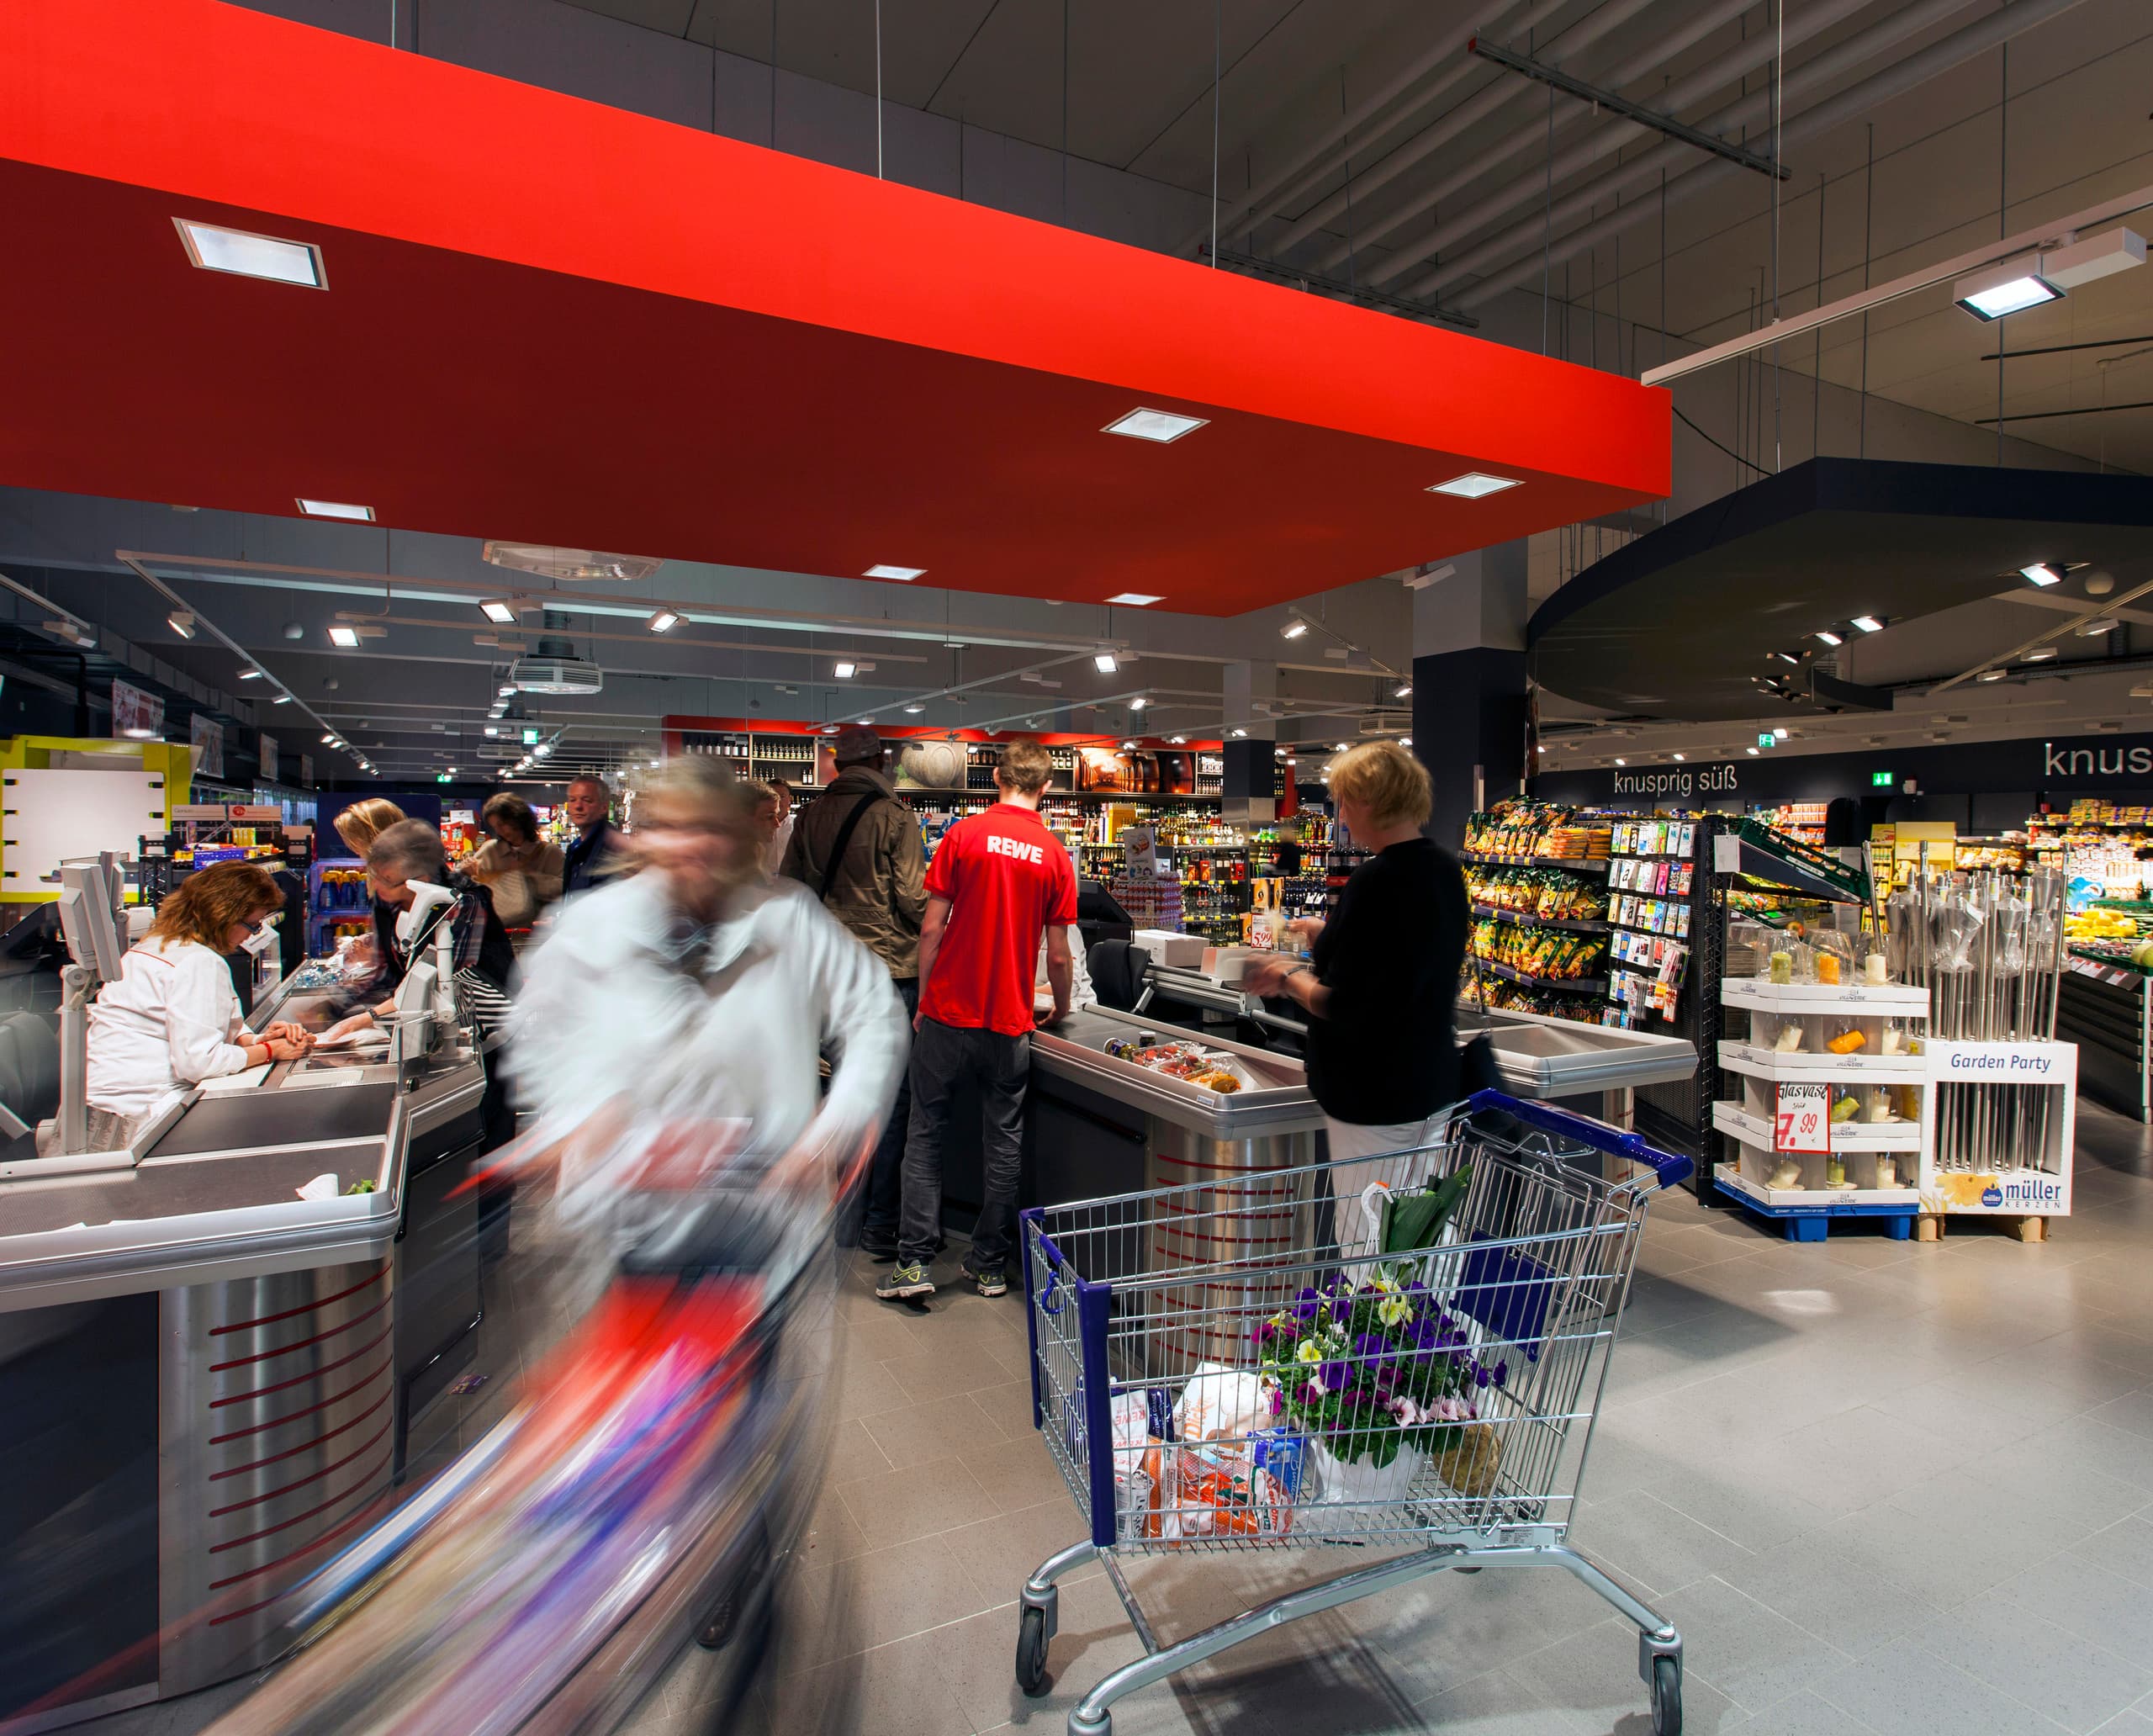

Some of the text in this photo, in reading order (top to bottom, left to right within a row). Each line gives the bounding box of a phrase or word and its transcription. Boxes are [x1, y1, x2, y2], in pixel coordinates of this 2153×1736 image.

[2045, 743, 2153, 775] knus
[1614, 765, 1738, 797] knusprig süß
[987, 835, 1044, 865] REWE
[1951, 1053, 2051, 1073] Garden Party
[1779, 1081, 1828, 1100] Glasvase
[2006, 1179, 2060, 1199] müller
